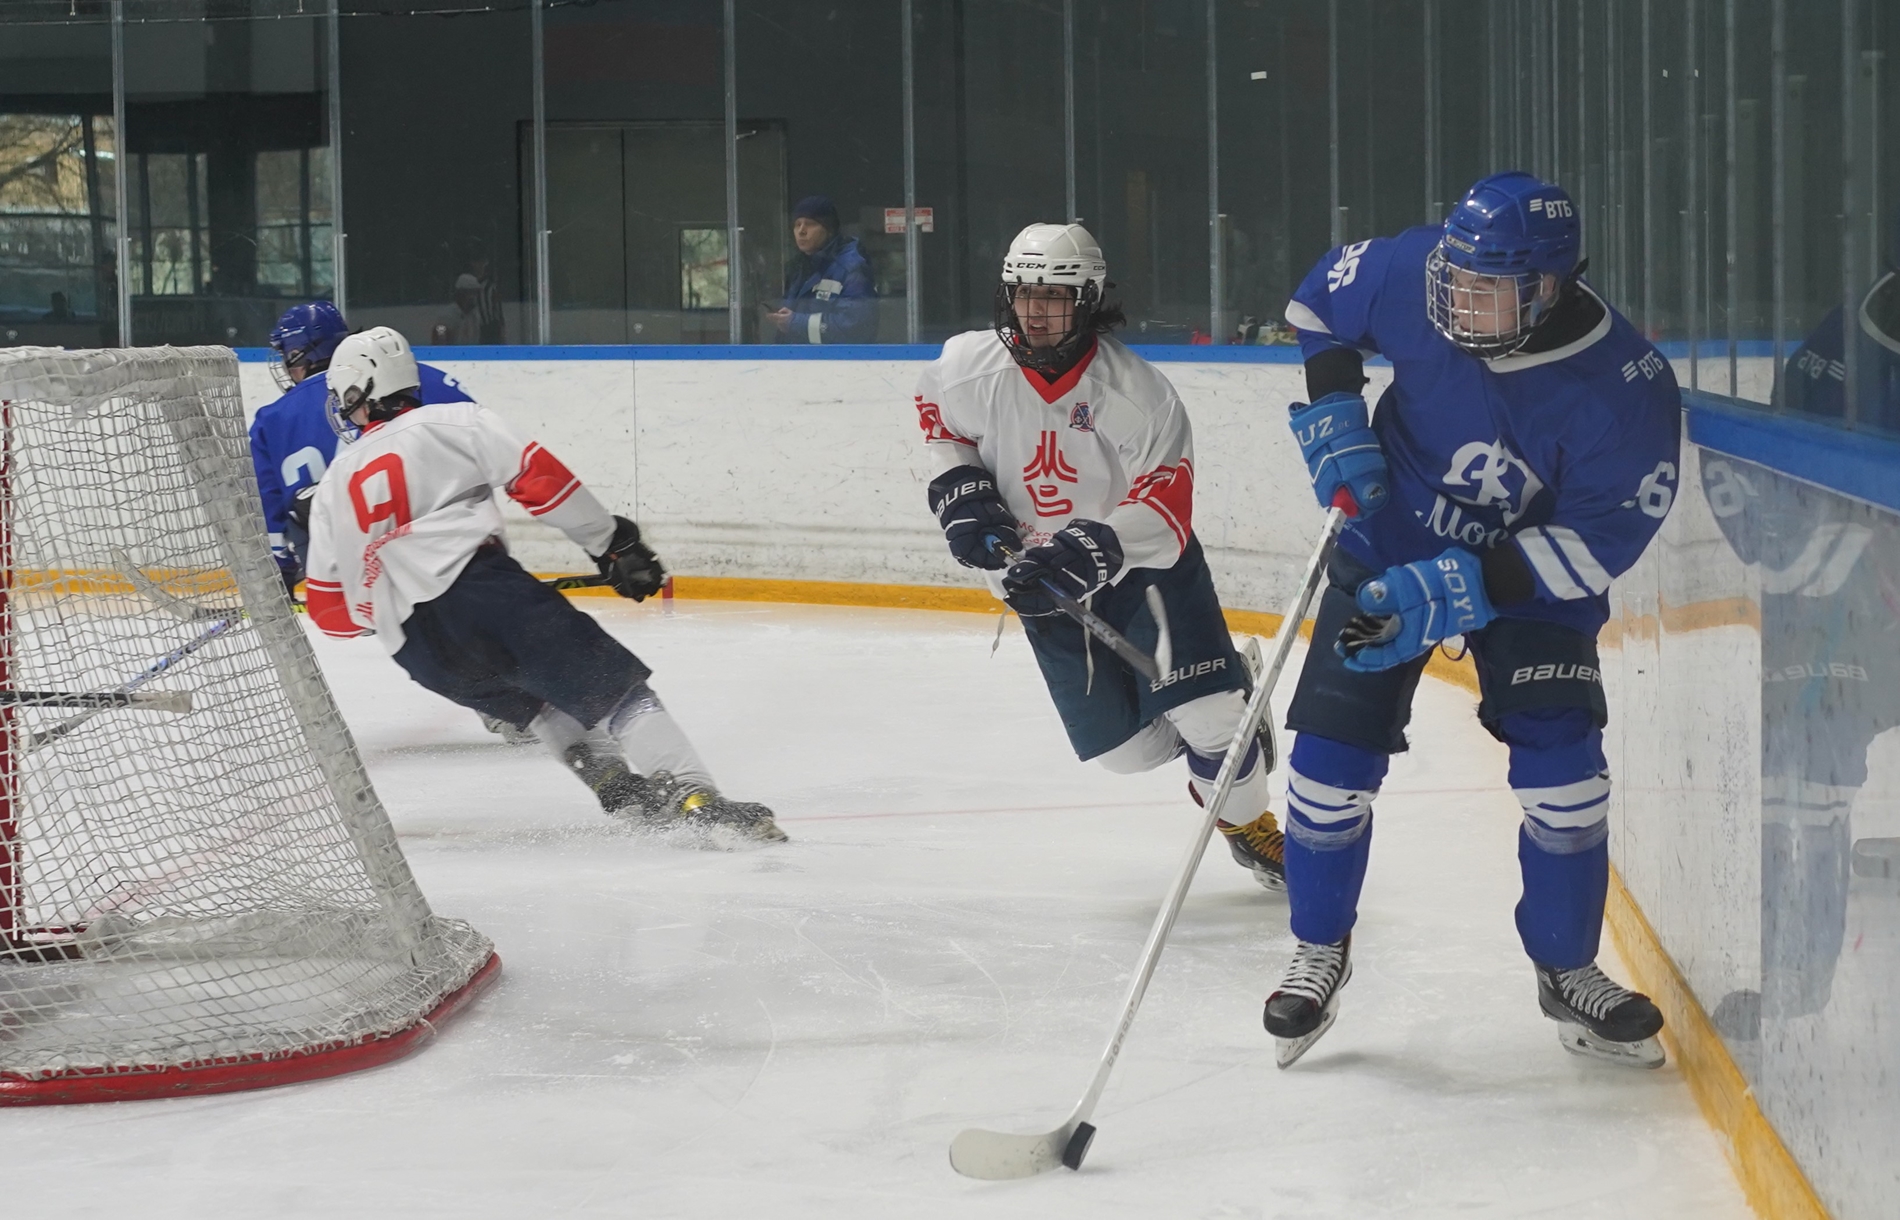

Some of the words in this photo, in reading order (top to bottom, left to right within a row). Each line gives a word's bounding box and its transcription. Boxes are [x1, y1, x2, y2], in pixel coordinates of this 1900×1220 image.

[1545, 201, 1572, 219] ВТБ
[1016, 262, 1047, 270] CCM
[1638, 350, 1664, 381] ВТБ
[347, 452, 413, 534] 9
